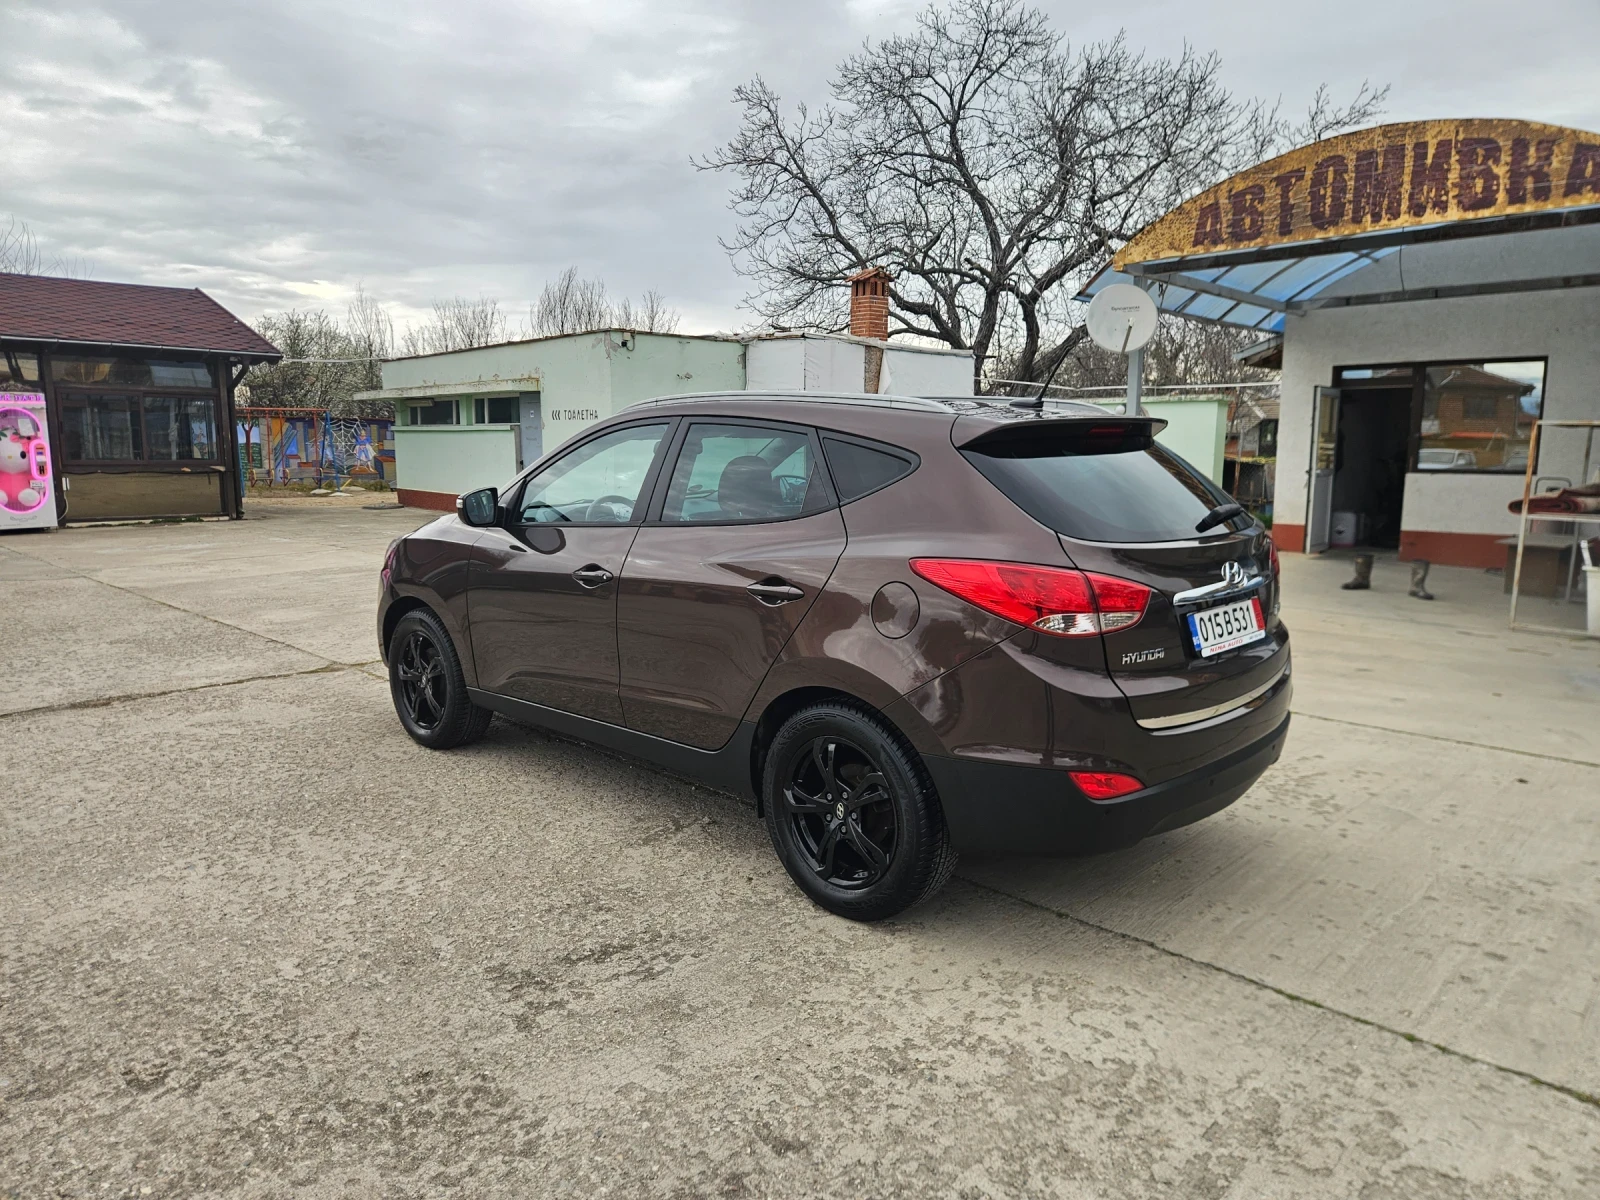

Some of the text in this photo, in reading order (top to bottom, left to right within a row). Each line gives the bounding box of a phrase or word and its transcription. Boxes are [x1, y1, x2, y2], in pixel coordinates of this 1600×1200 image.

[564, 409, 598, 420] ТОАЛЕТНА
[1200, 604, 1253, 642] 015B531
[1210, 639, 1243, 653] NINA AUTO
[1122, 648, 1164, 665] HYUNDAI
